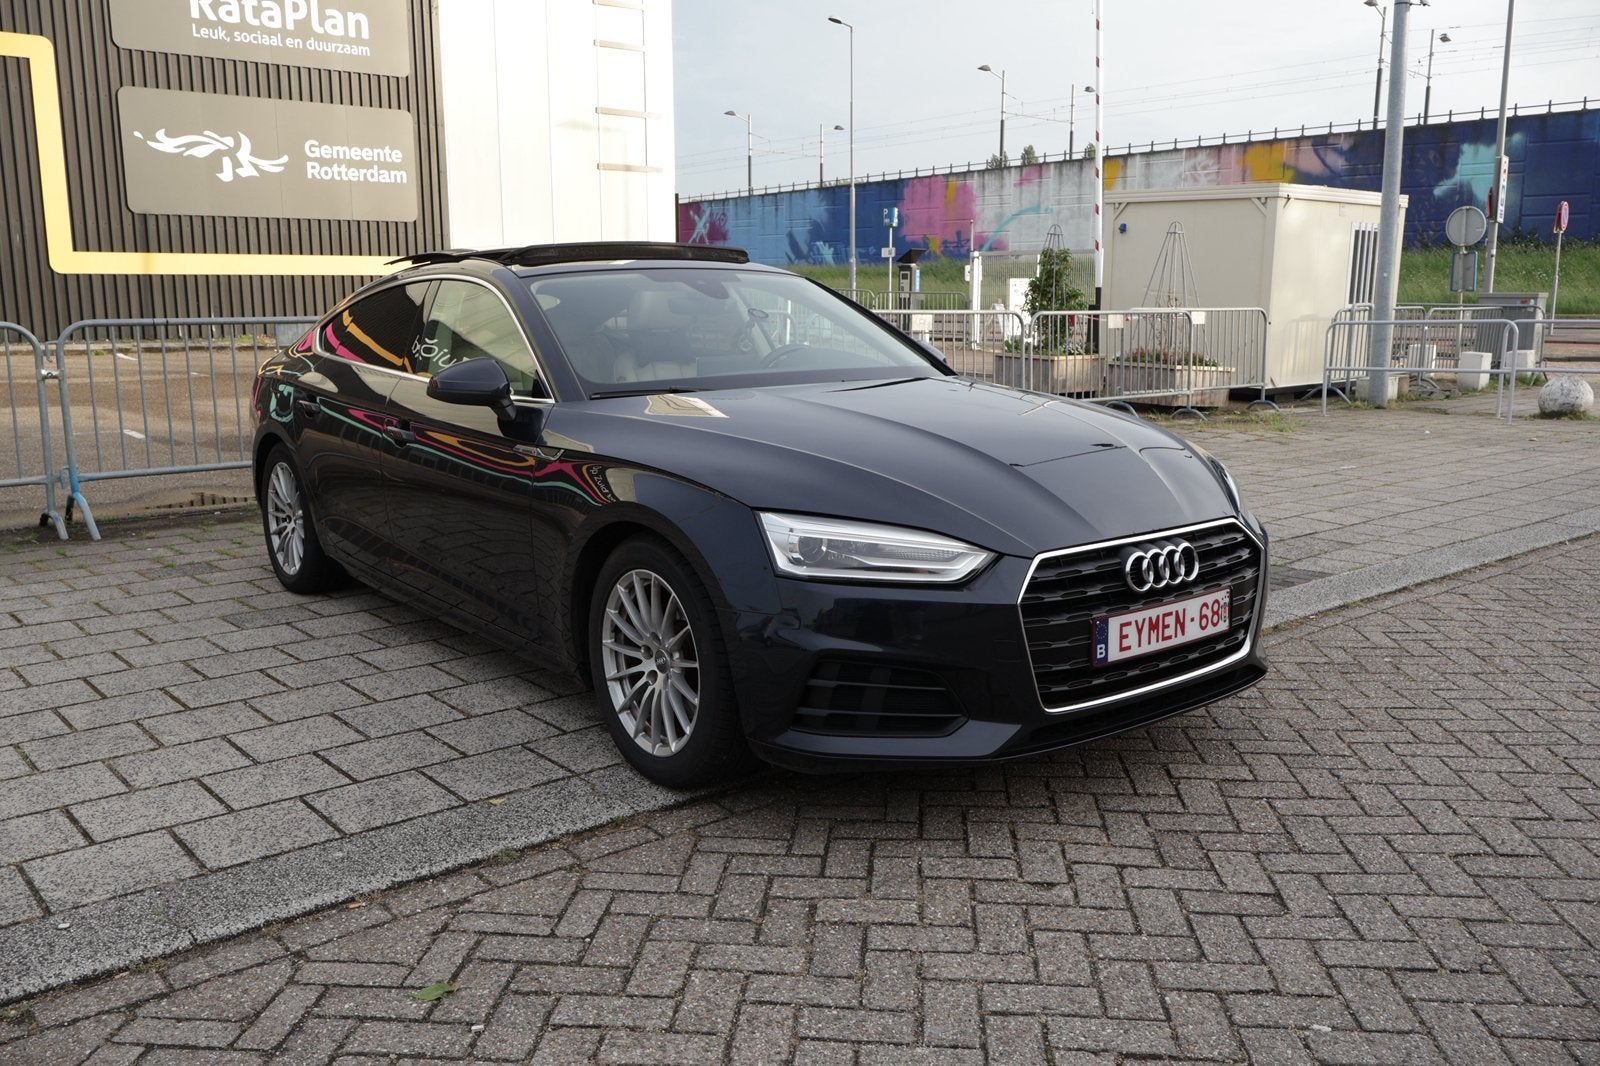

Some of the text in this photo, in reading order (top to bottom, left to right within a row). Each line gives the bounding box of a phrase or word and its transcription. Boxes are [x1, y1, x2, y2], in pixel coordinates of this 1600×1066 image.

[192, 23, 371, 56] Leuk, sociaal en duurzaam
[304, 139, 403, 163] Gemeente
[306, 161, 407, 184] Rotterdam
[1097, 645, 1106, 659] B
